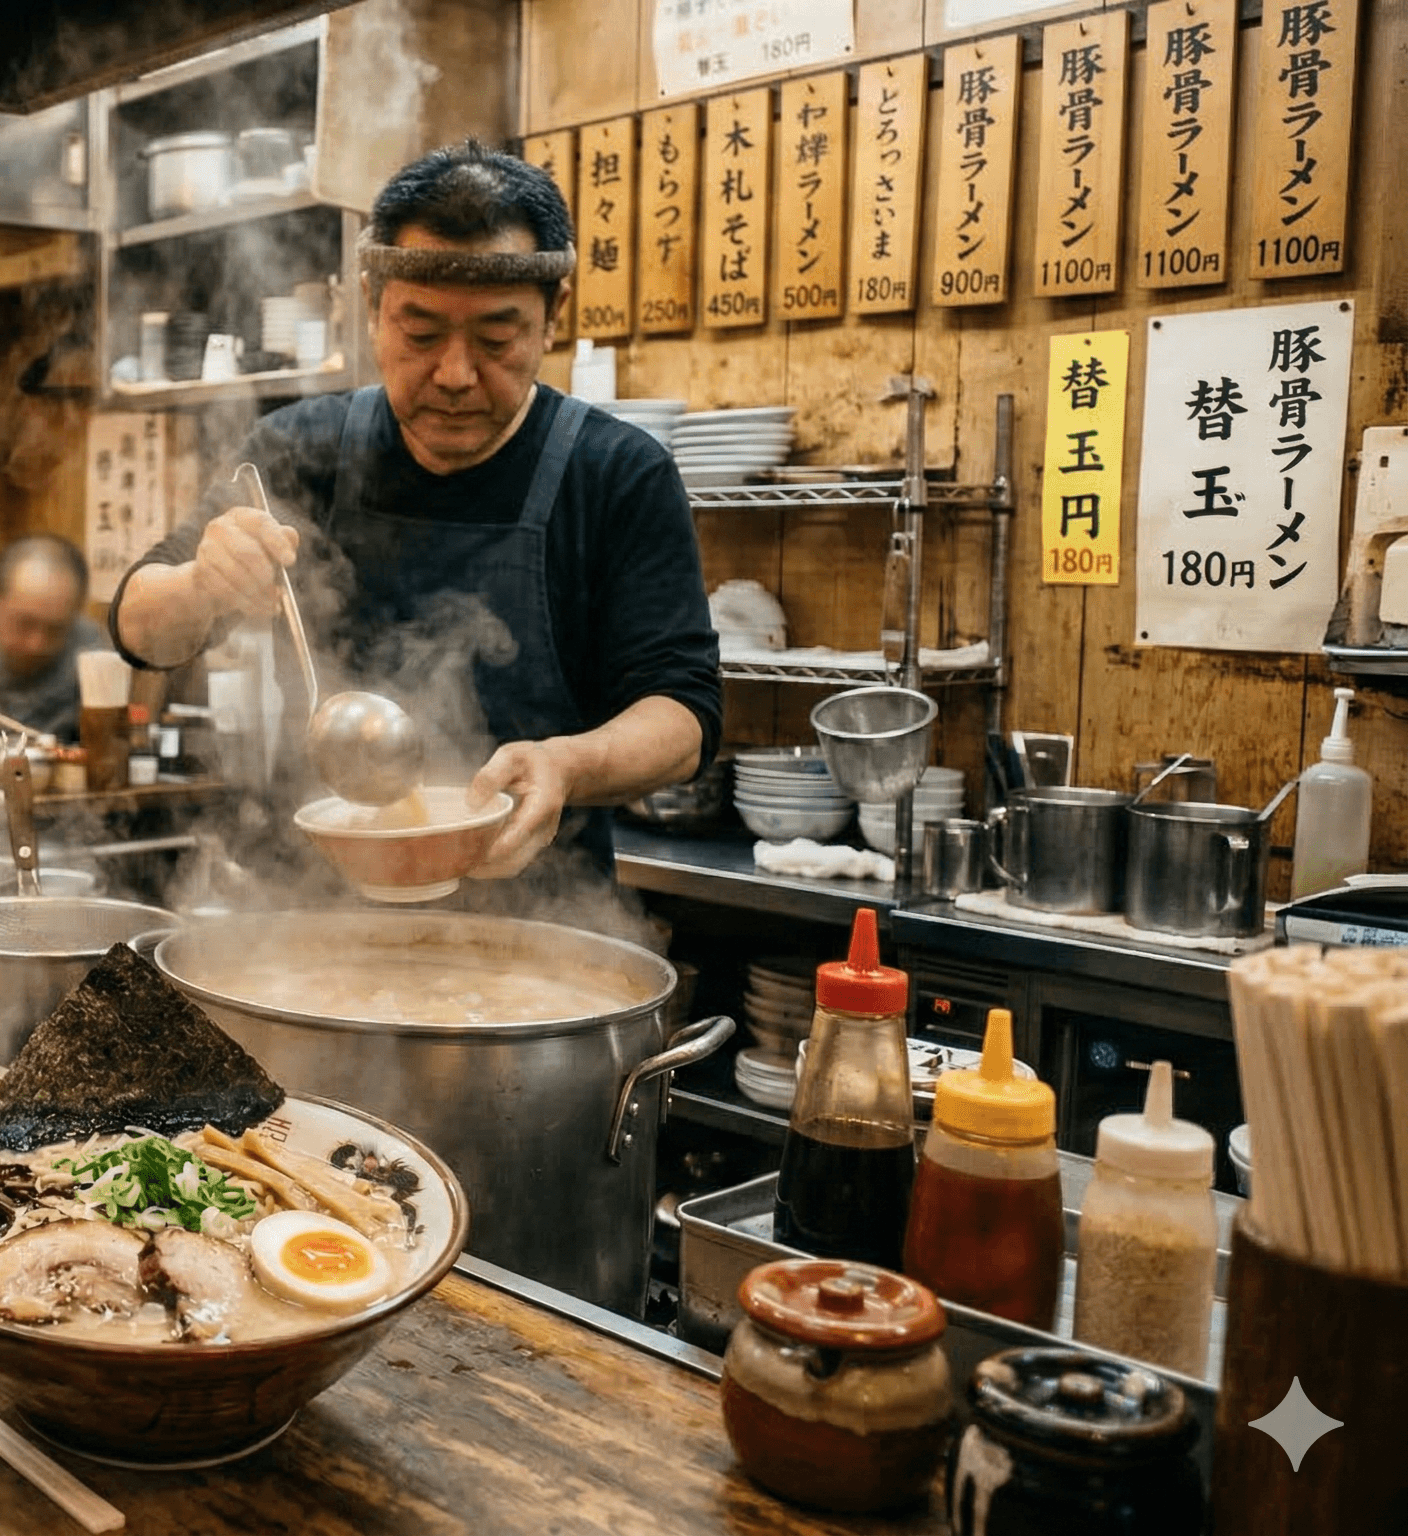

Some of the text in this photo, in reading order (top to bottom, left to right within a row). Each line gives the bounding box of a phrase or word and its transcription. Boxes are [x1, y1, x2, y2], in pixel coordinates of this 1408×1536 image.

[762, 32, 811, 61] 180円
[1276, 0, 1337, 227] 豚骨ラーメン
[1163, 22, 1216, 237] 豚骨ラーメン
[1058, 44, 1106, 248] 豚骨ラーメン
[957, 66, 999, 261] 豚骨ラーメン
[1144, 247, 1219, 277] 1100円
[1258, 235, 1340, 267] 1100円
[941, 269, 1000, 296] 900円
[1042, 257, 1111, 286] 1100円
[783, 284, 837, 309] 500円
[857, 276, 907, 302] 180円
[581, 304, 626, 330] 300円
[642, 297, 689, 324] 250円
[707, 291, 760, 317] 450円
[1057, 356, 1110, 540] 替玉円
[1265, 325, 1328, 590] 豚骨ラーメン
[1048, 547, 1113, 576] 180円
[1161, 549, 1255, 590] 180円
